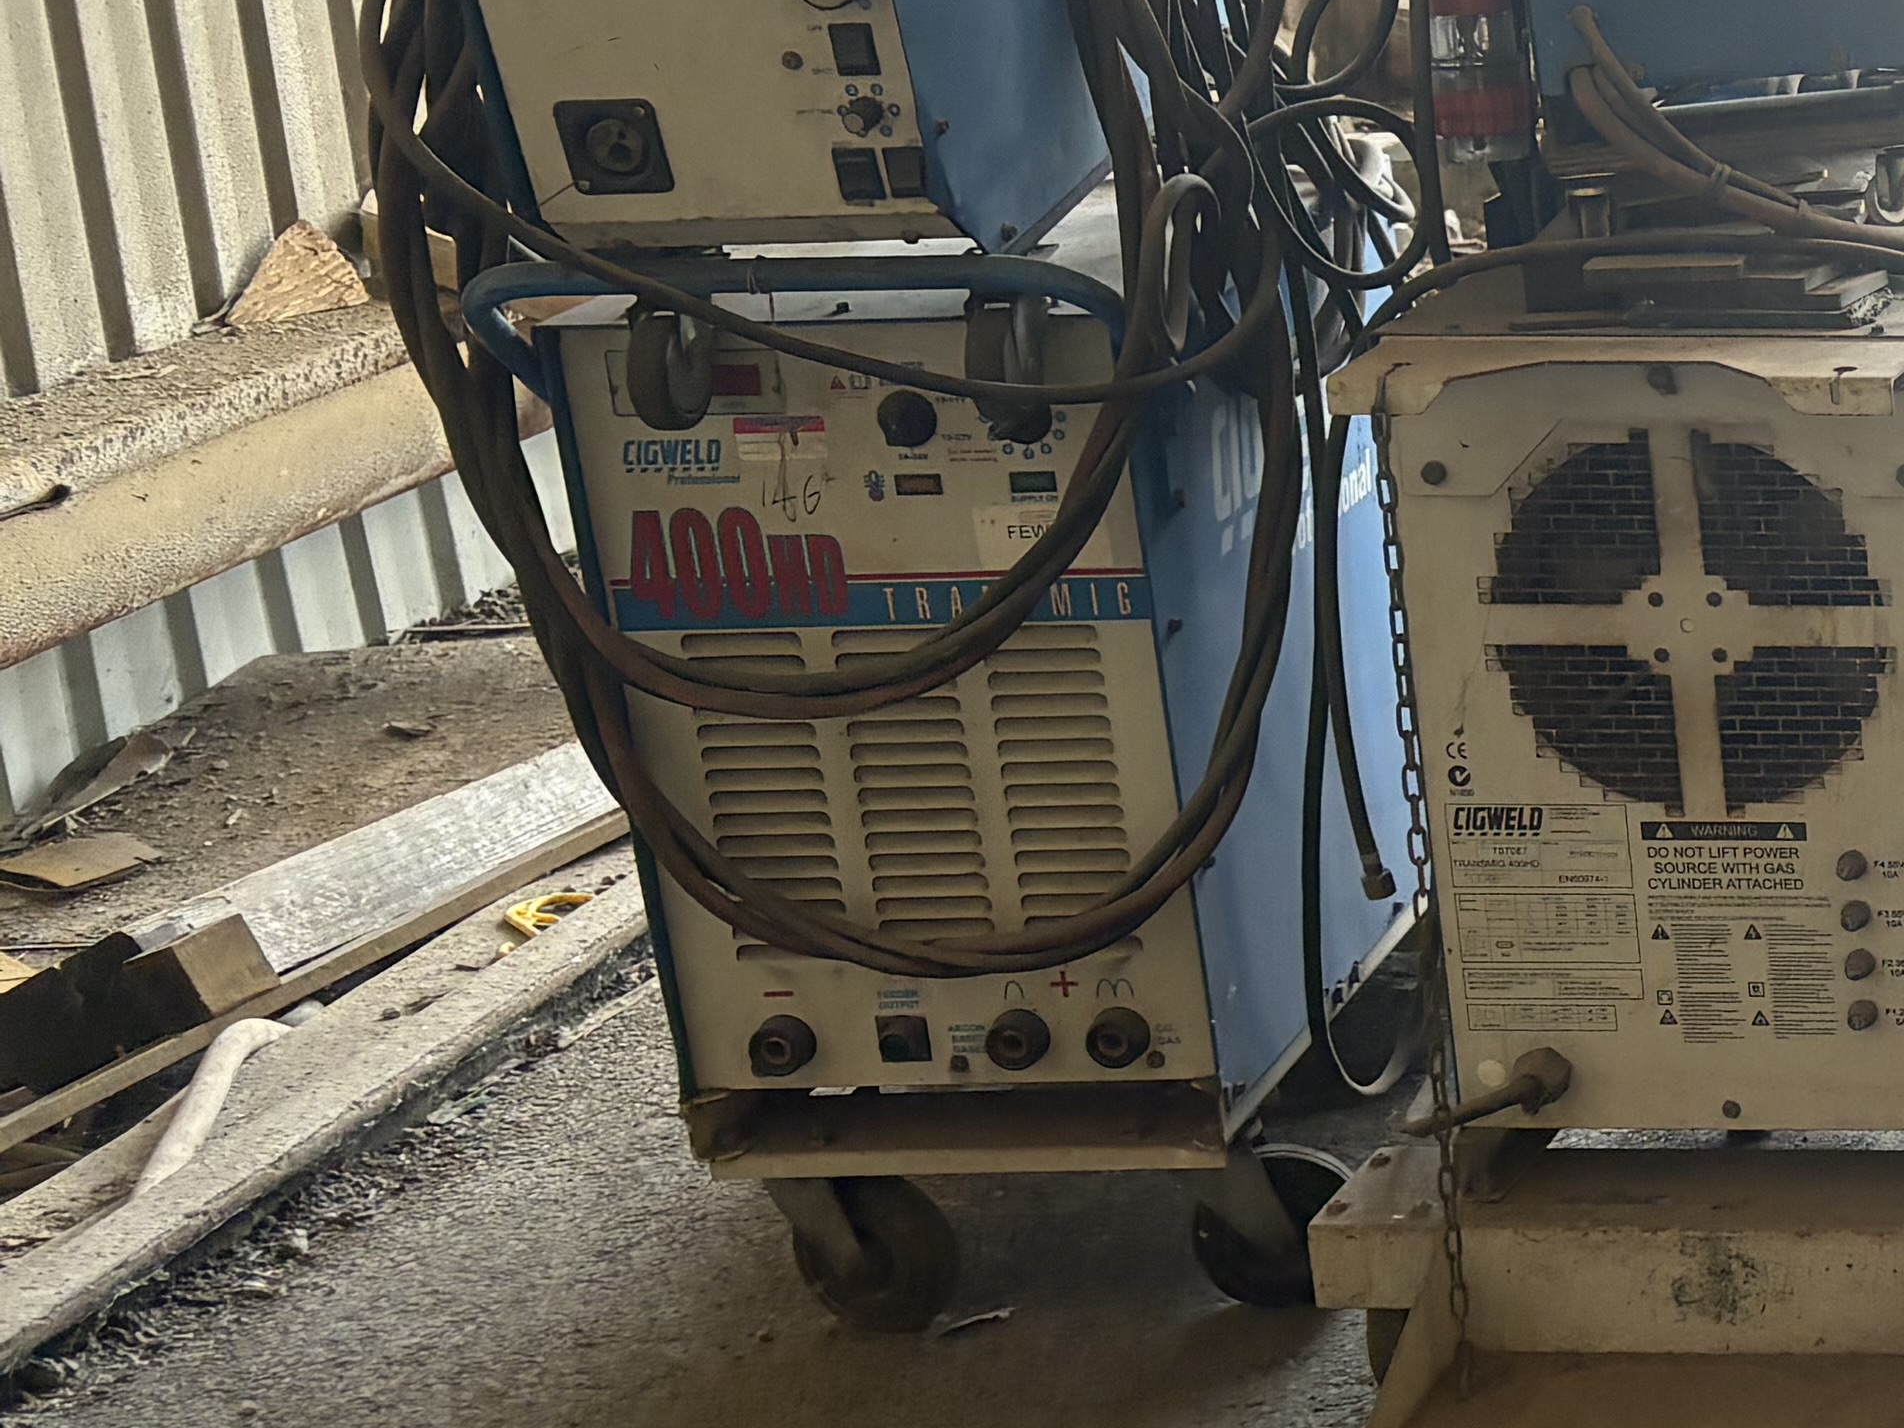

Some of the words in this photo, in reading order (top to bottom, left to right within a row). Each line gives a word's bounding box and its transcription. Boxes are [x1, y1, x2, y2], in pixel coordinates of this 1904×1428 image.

[623, 440, 721, 465] CIGWELD
[1007, 525, 1048, 540] FEW
[631, 507, 848, 620] 400HD
[882, 582, 1132, 622] TRAMIG
[1453, 806, 1544, 831] CIGWELD
[1691, 824, 1758, 837] WARNING
[1647, 847, 1669, 858] DO
[1673, 846, 1705, 858] NOT
[1708, 846, 1740, 859] LIFT
[1743, 847, 1800, 859] POWER
[1654, 862, 1718, 874] SOURCE
[1721, 862, 1760, 874] WITH
[1763, 862, 1796, 875] GAS
[1647, 878, 1725, 890] CYLINDER
[1726, 878, 1805, 890] ATTACHED
